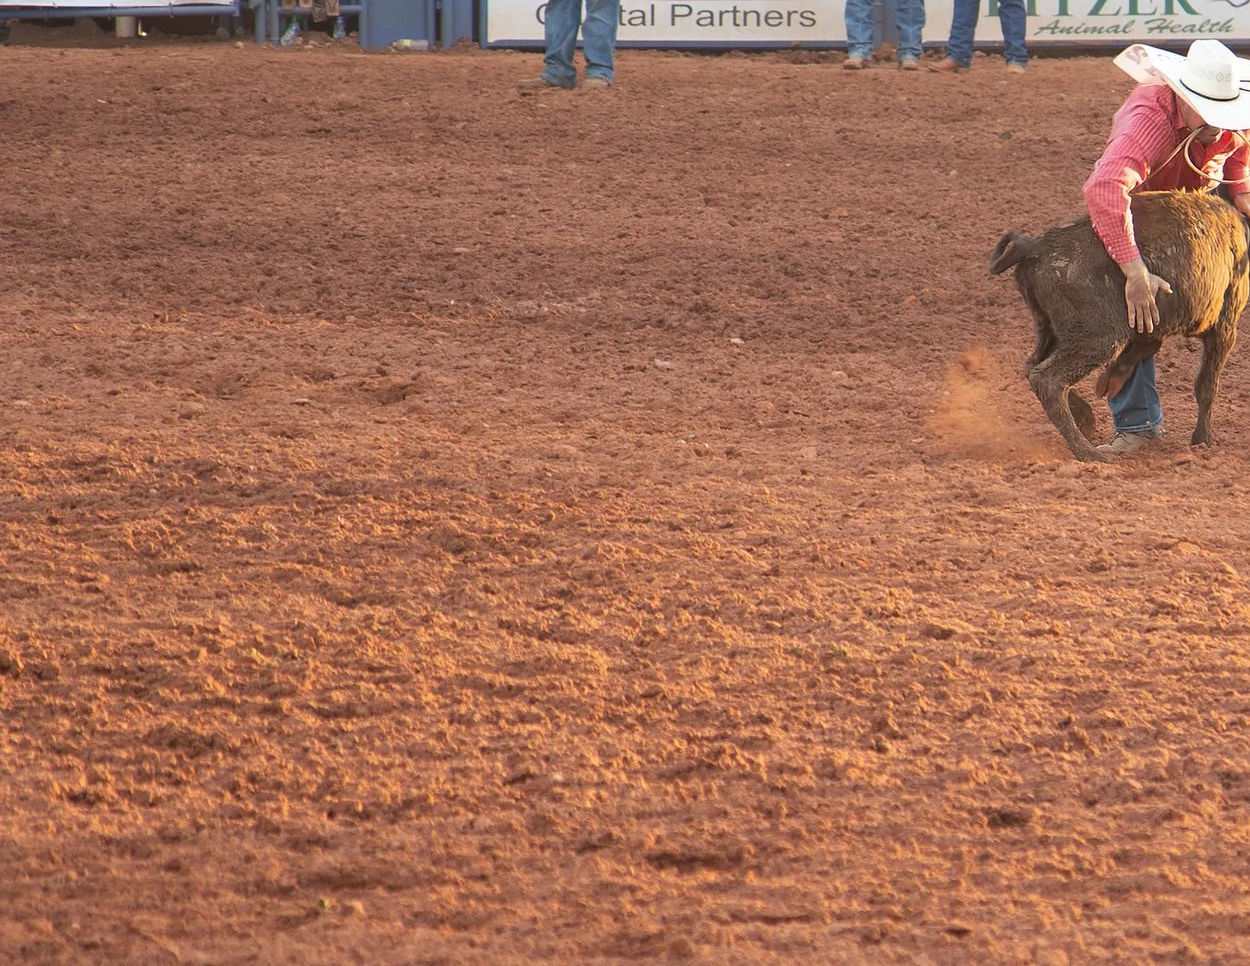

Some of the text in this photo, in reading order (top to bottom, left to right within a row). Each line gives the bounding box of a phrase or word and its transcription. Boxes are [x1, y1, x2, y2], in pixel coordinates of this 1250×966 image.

[671, 3, 817, 28] Partners
[1033, 17, 1236, 36] Animal Health
